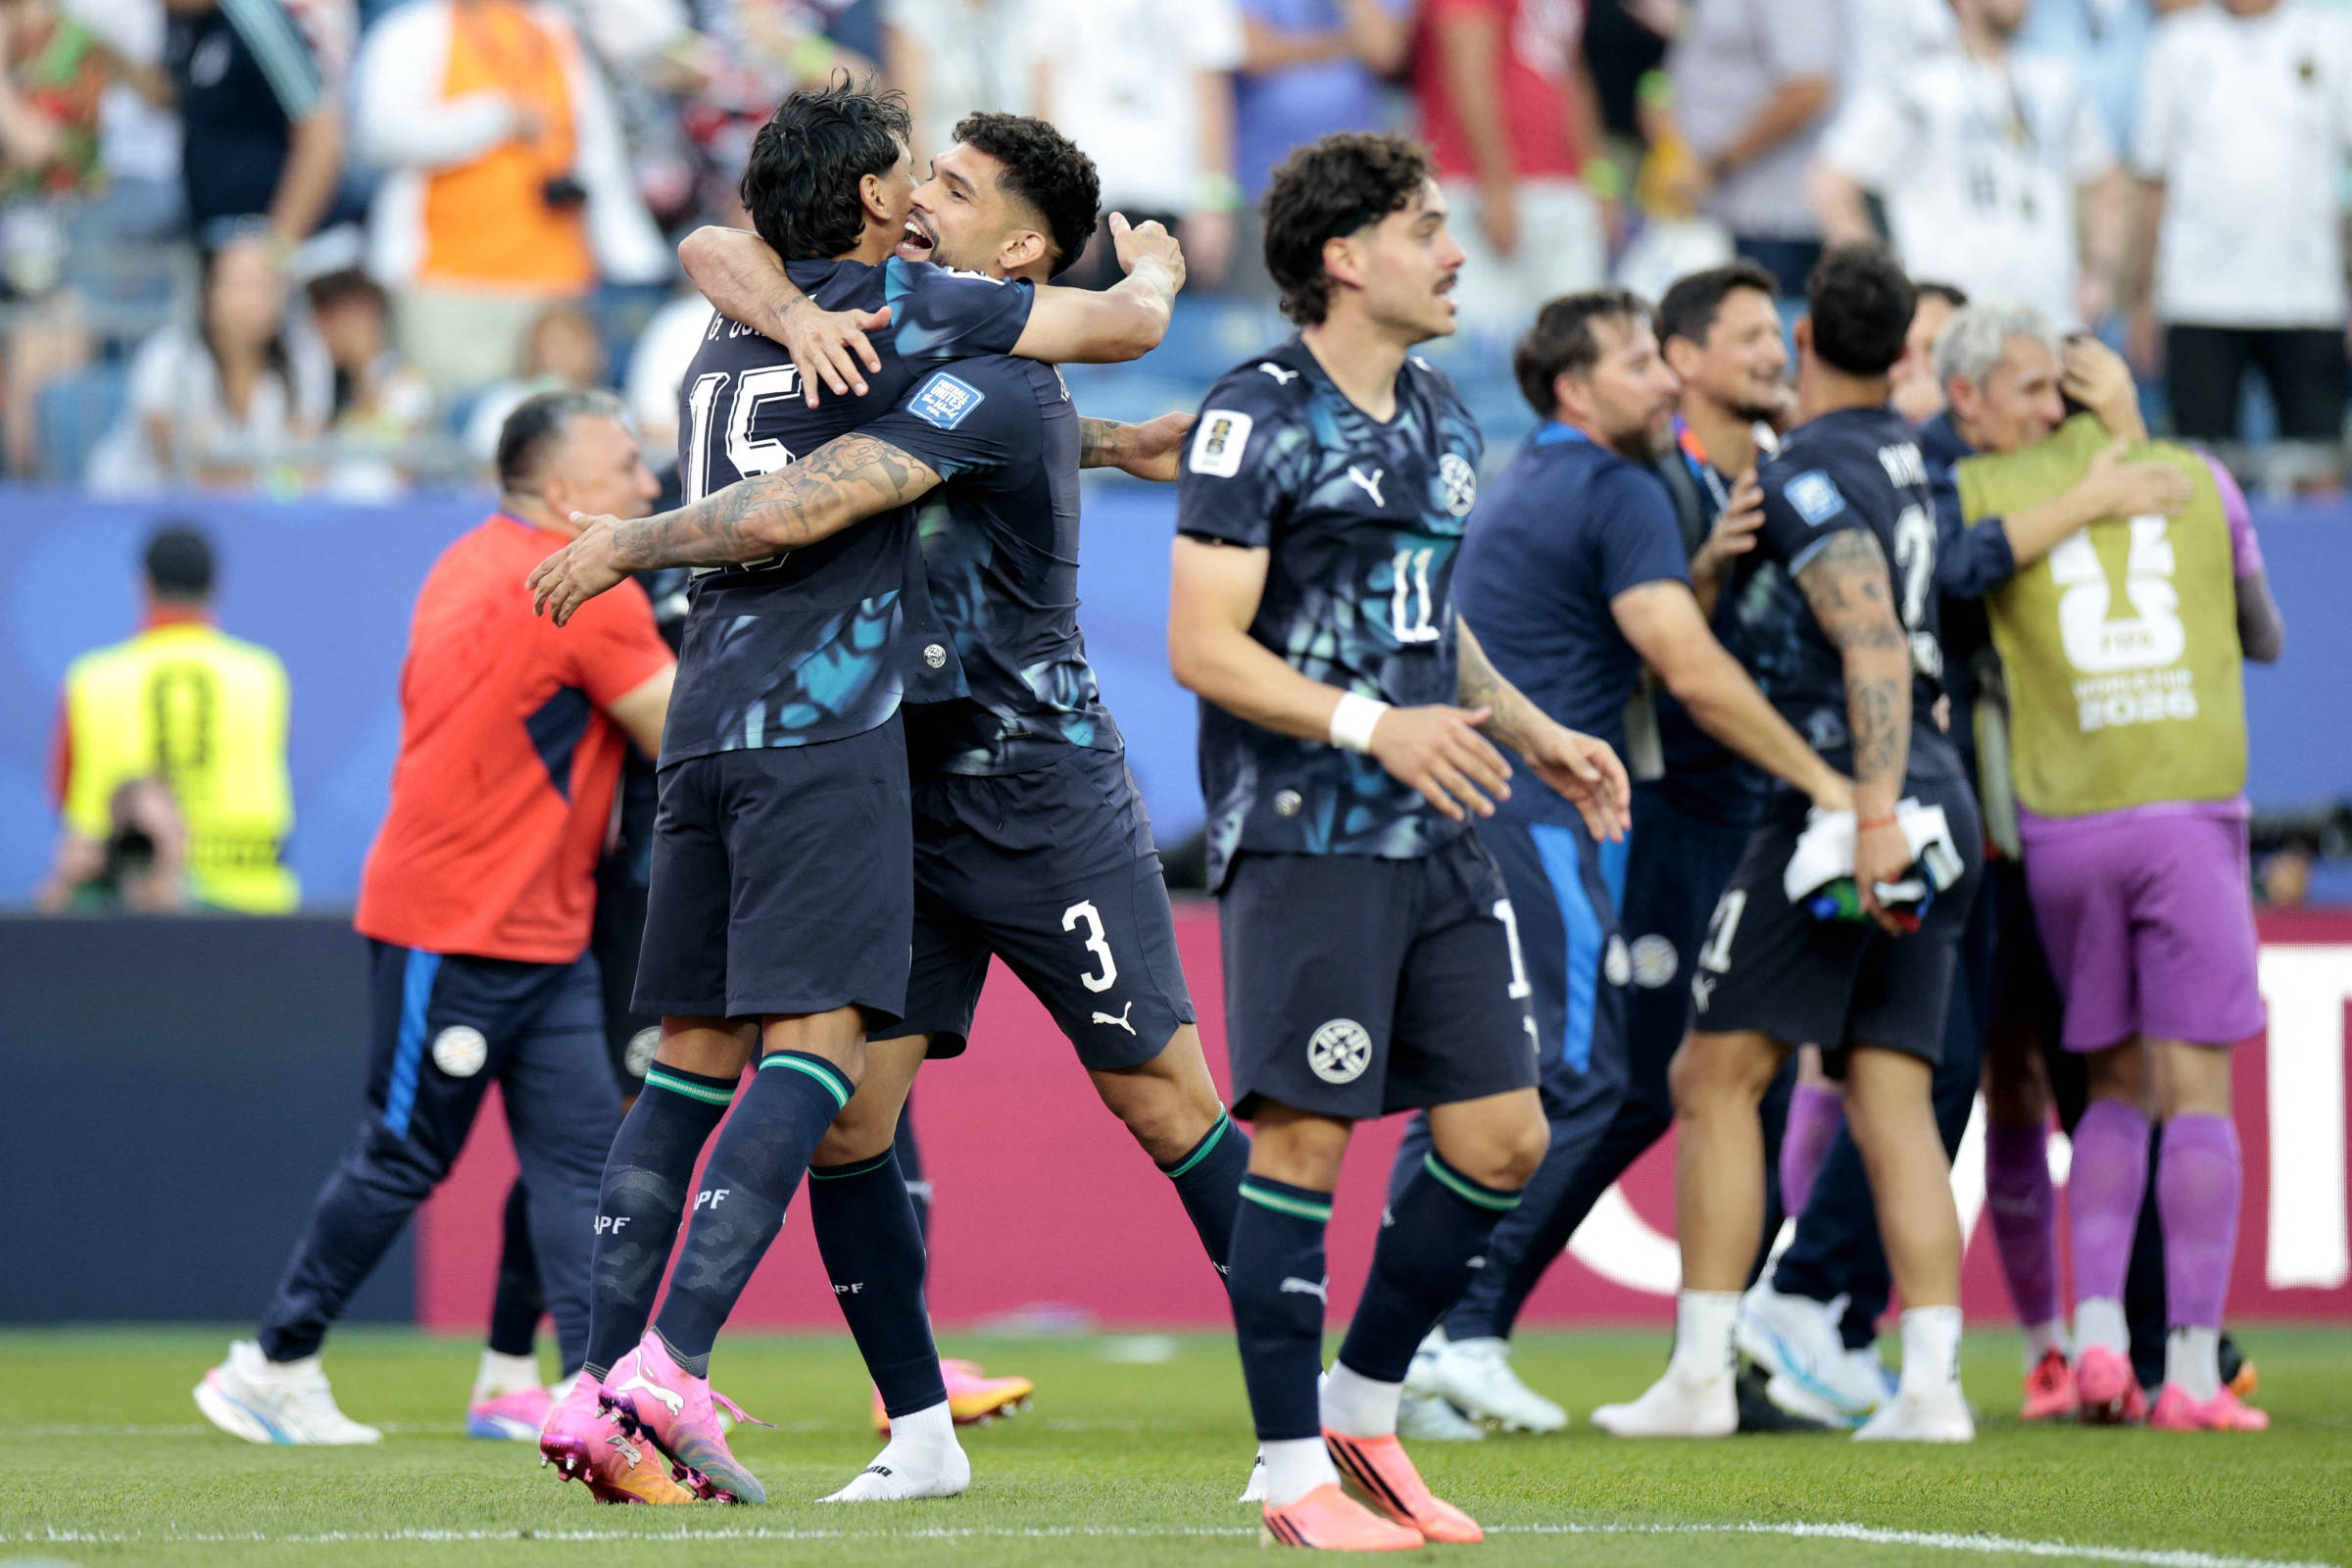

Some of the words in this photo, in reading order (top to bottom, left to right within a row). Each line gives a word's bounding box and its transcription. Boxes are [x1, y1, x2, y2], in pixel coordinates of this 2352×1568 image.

[688, 363, 804, 579] 15
[1392, 548, 1441, 643] 11
[1061, 900, 1118, 994] 3
